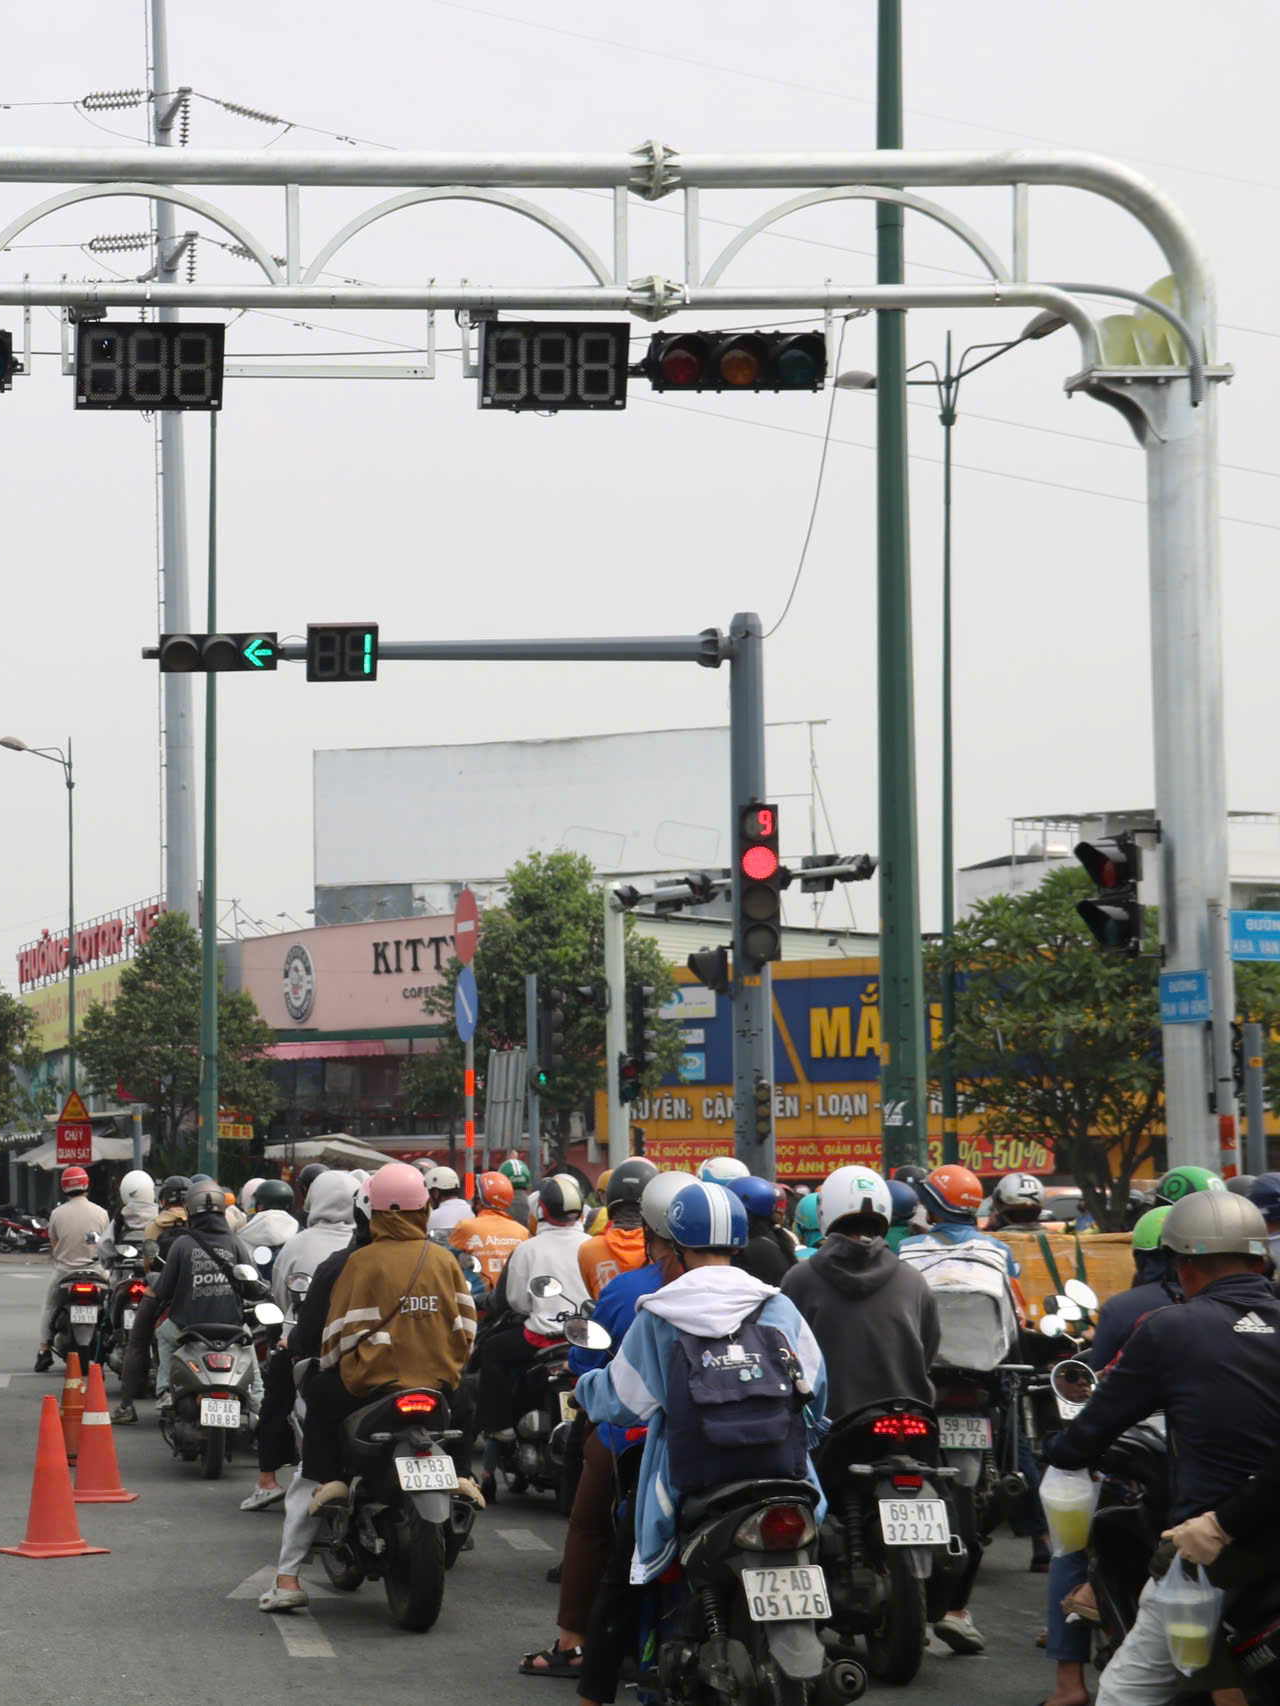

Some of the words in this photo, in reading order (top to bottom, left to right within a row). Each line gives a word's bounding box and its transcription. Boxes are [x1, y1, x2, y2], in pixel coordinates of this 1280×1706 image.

[758, 809, 773, 836] 9
[372, 935, 461, 975] KITT
[817, 1093, 868, 1122] LOẠN
[58, 1148, 77, 1159] QUAN
[77, 1147, 91, 1159] SÁT
[1233, 1325, 1275, 1334] adidas
[207, 1402, 233, 1413] 60-AK
[204, 1413, 238, 1426] 108.85
[405, 1459, 445, 1474] 81-B3
[404, 1474, 453, 1489] 202.90
[890, 1503, 935, 1521] 69-M1
[887, 1523, 945, 1542] 323.21
[755, 1570, 813, 1593] 72-AB
[752, 1593, 825, 1617] 051.26
